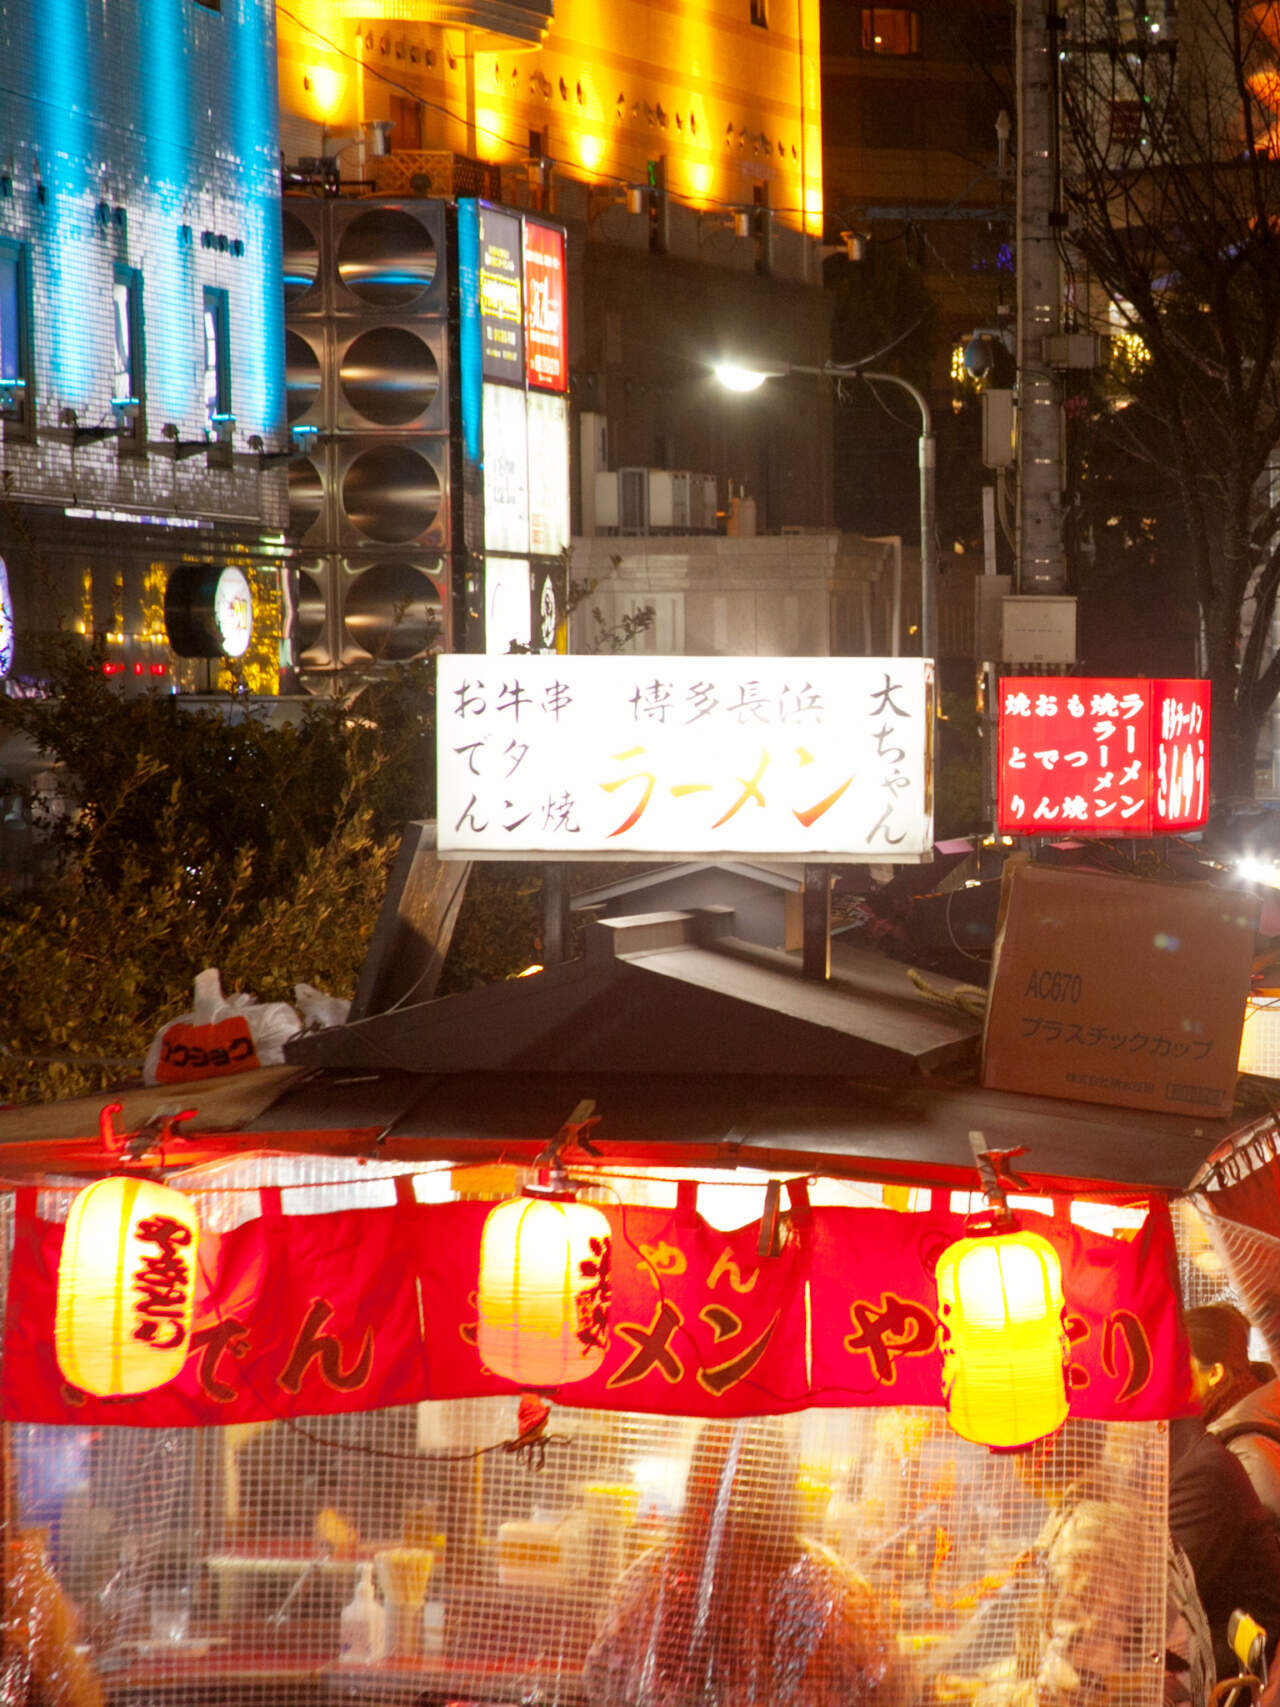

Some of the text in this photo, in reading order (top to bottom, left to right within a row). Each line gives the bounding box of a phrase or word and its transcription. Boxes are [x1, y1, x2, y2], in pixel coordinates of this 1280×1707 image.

[453, 680, 492, 833] おでん
[497, 679, 533, 833] 牛タン
[629, 679, 825, 725] 博多長浜
[866, 672, 911, 845] 大ちゃん
[1005, 692, 1032, 820] 焼とり
[1033, 694, 1060, 820] おでん
[1062, 694, 1089, 821] もつ焼
[1090, 692, 1119, 818] 焼ラーメン
[1118, 693, 1145, 819] ラーメン
[599, 745, 856, 839] ラーメン
[1021, 1016, 1215, 1061] プラスチックカップ
[1023, 968, 1083, 1005] AC670
